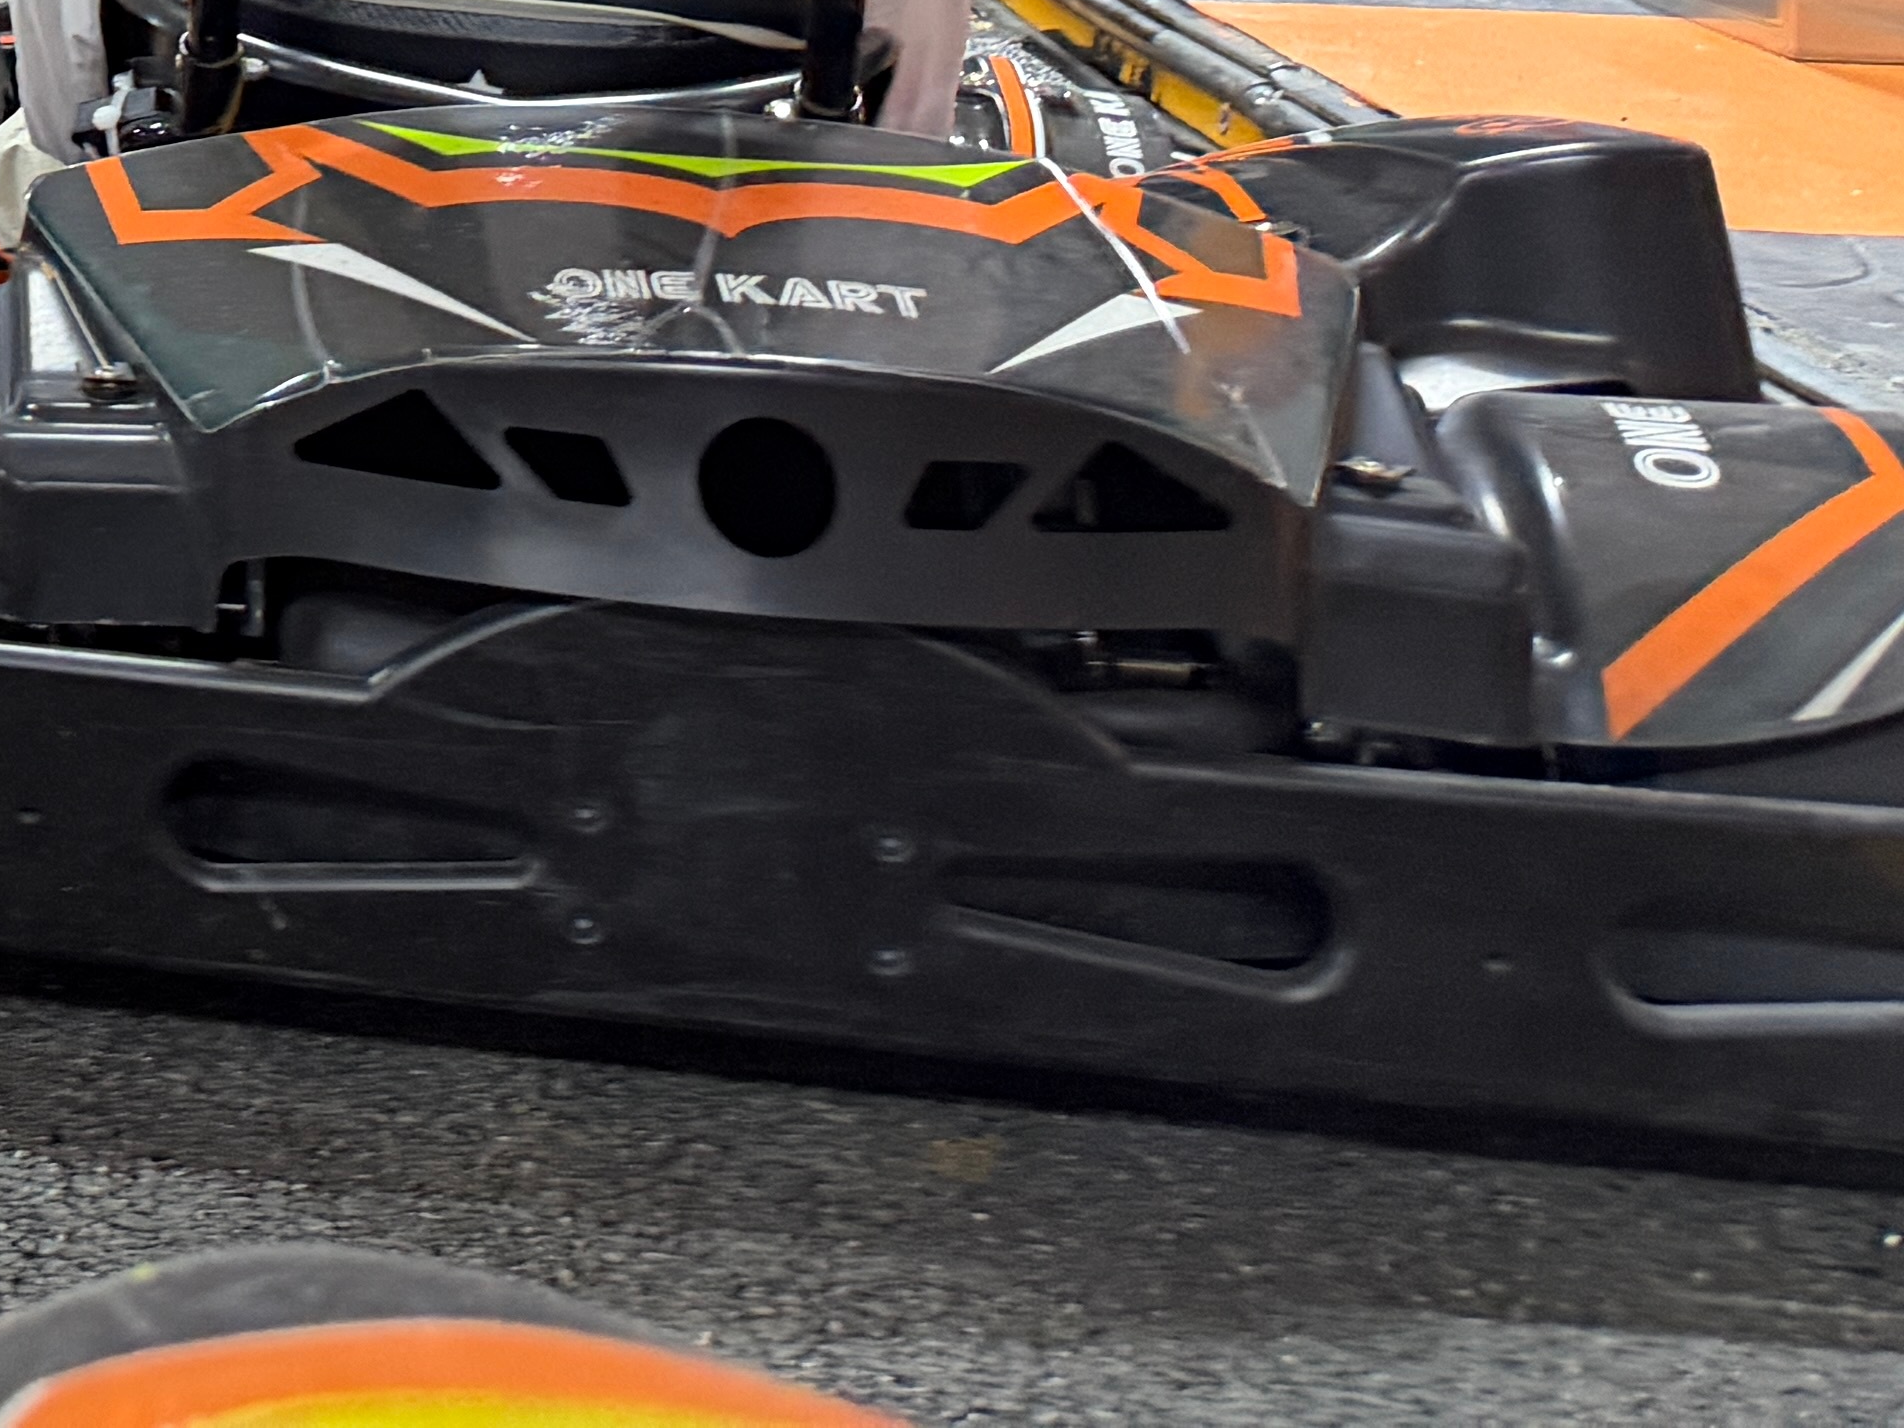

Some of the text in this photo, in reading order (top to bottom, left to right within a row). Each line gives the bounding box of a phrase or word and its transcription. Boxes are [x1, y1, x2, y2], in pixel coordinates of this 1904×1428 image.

[1097, 116, 1146, 179] ONE
[547, 267, 929, 320] ONE KART
[1600, 401, 1722, 489] ONE
